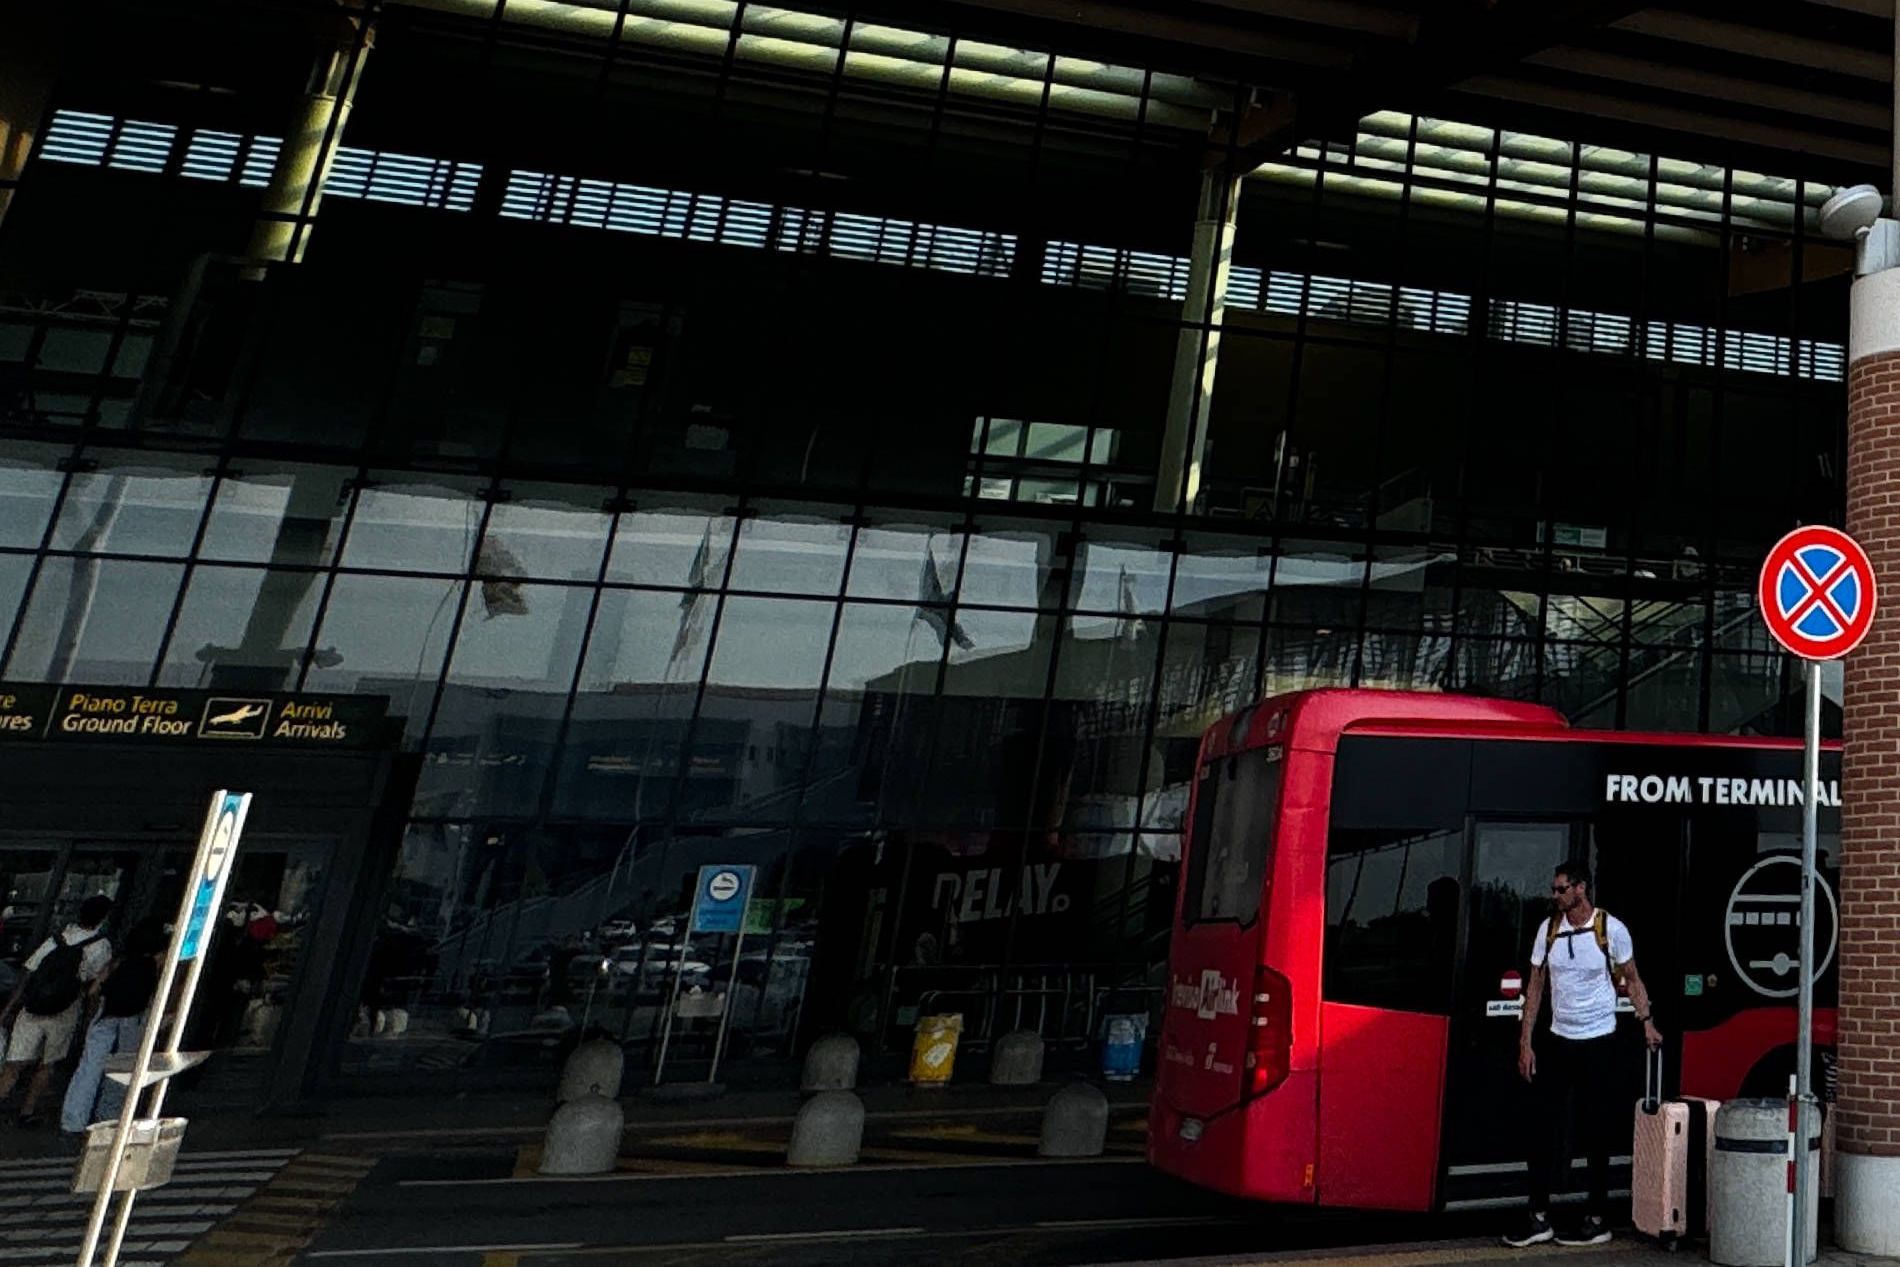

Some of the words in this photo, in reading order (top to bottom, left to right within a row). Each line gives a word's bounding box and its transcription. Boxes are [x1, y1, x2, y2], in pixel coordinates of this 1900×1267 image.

[68, 693, 127, 713] Piano
[131, 695, 178, 715] Terra
[279, 699, 334, 720] Arrivi
[62, 712, 139, 733] Ground
[141, 714, 193, 735] Floor
[271, 719, 347, 740] Arrivals
[1606, 774, 1692, 803] FROM
[1700, 776, 1843, 807] TERMINAL
